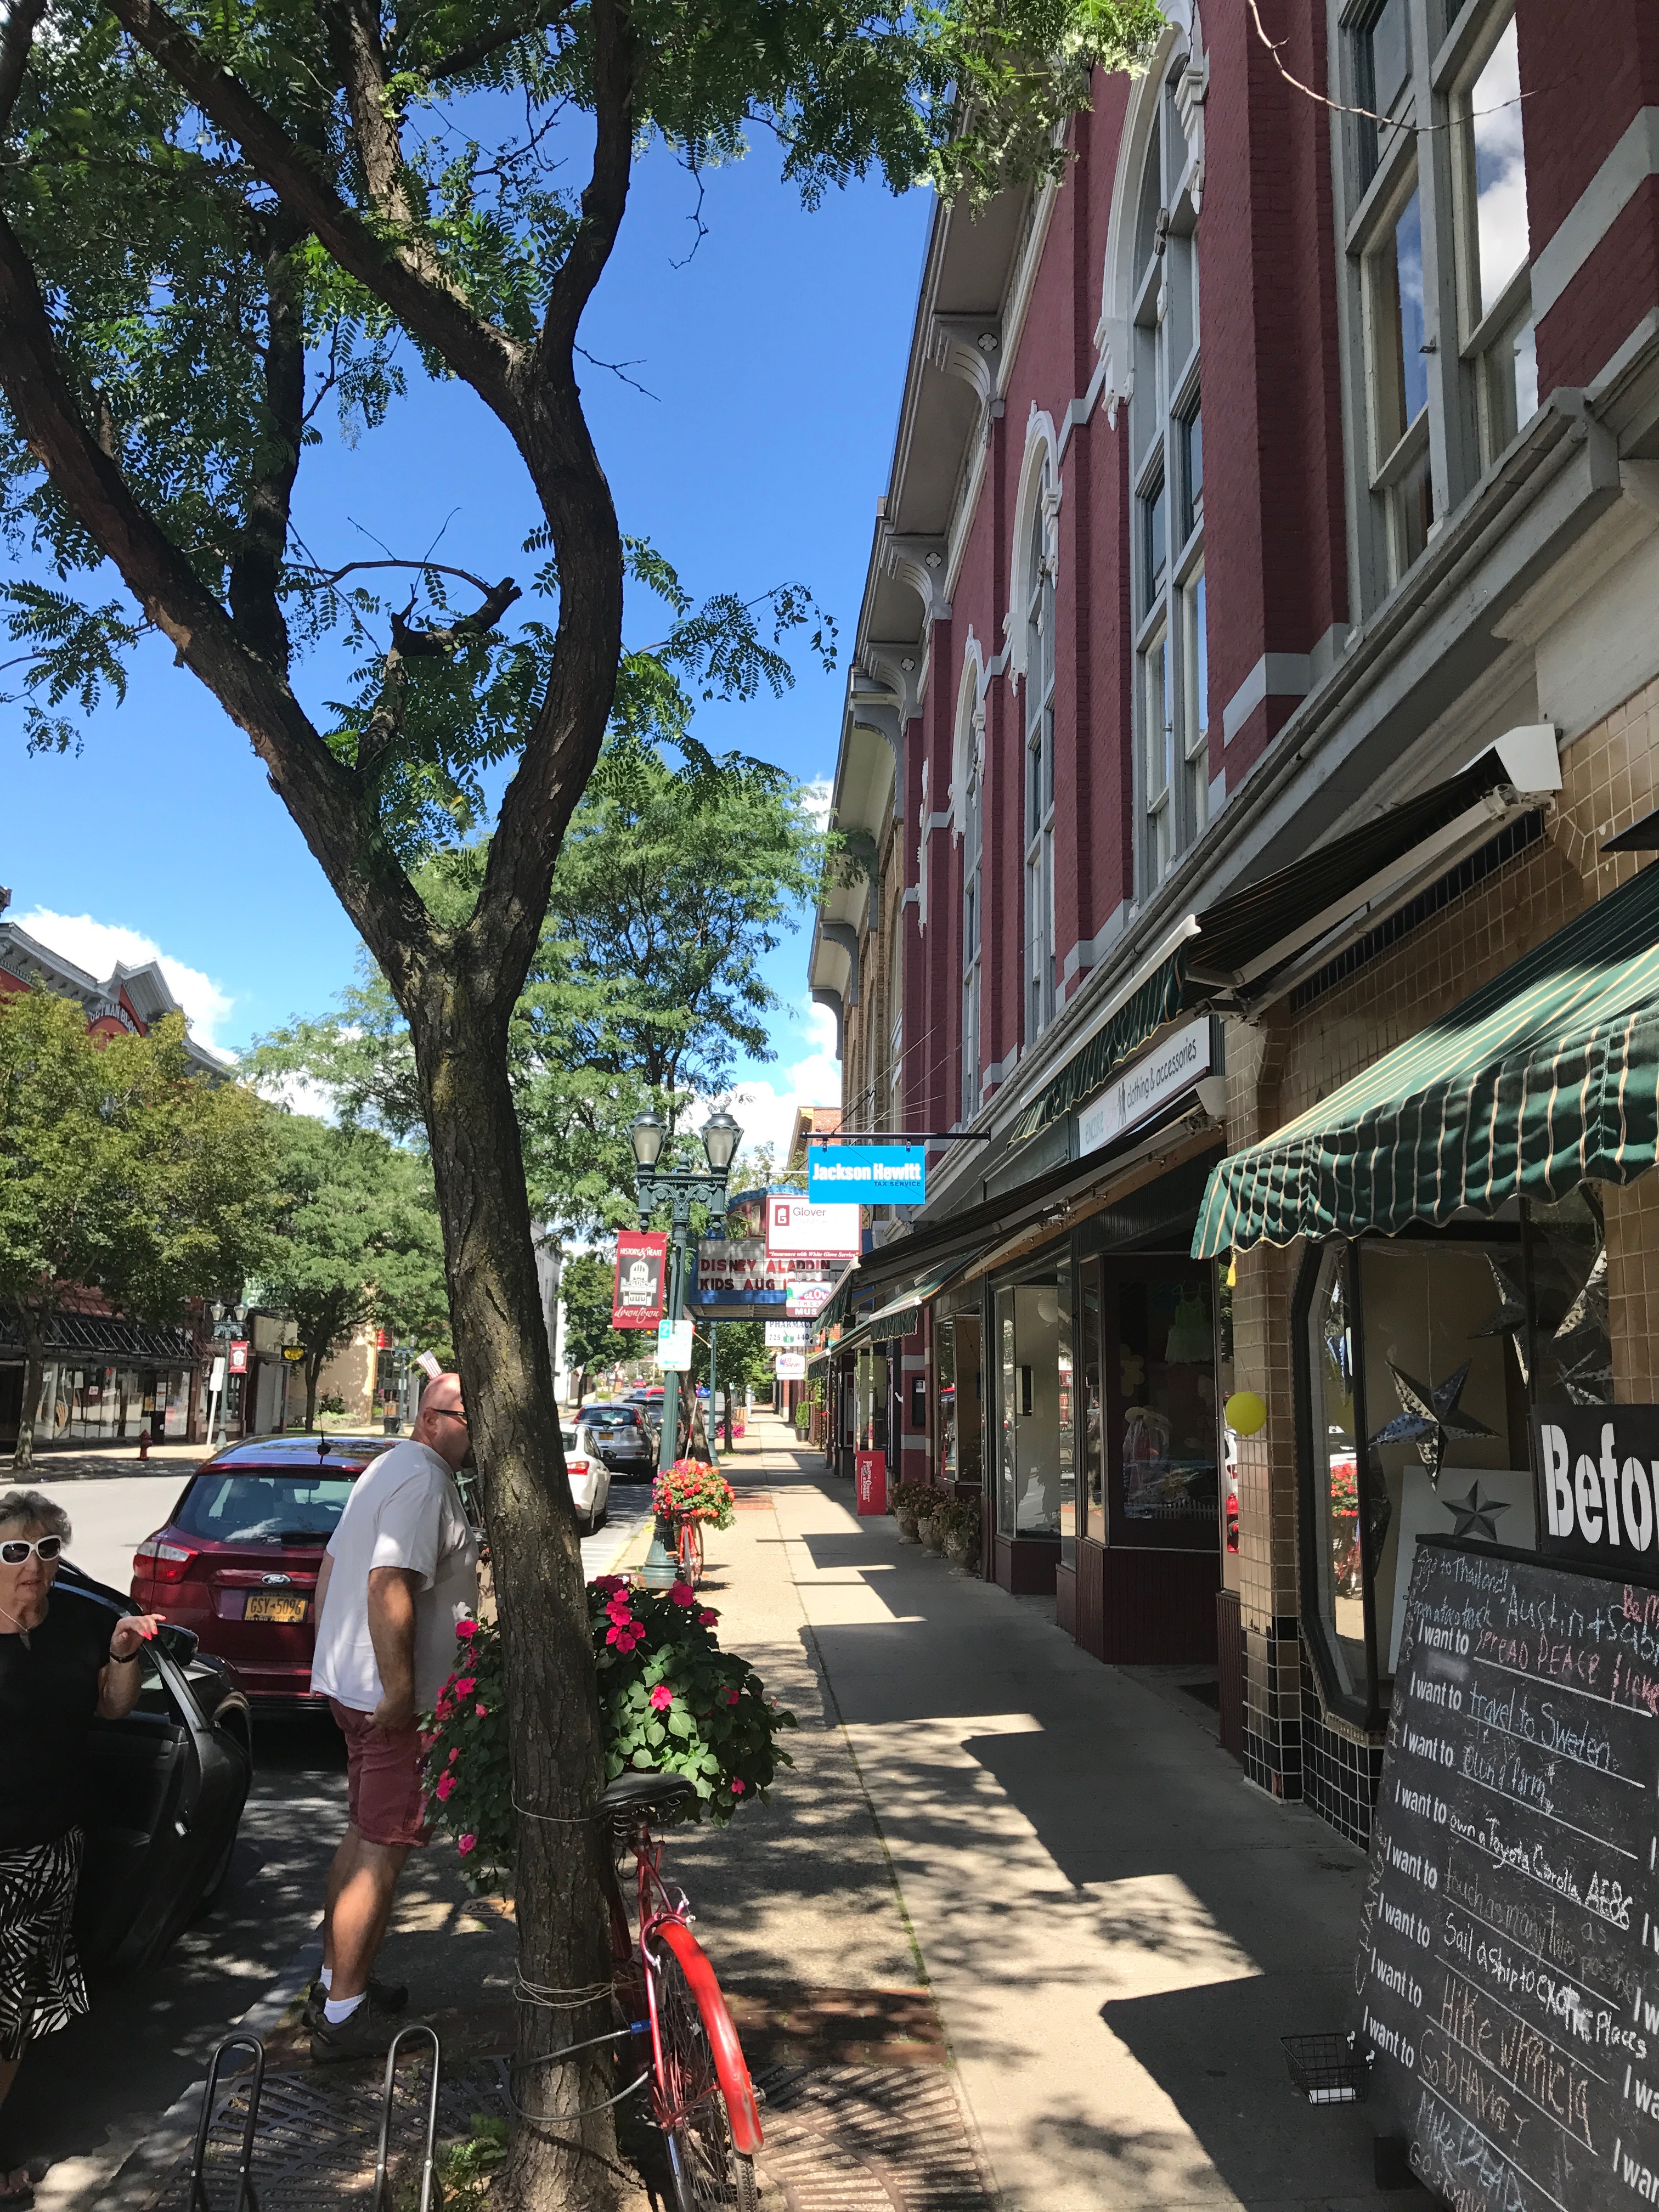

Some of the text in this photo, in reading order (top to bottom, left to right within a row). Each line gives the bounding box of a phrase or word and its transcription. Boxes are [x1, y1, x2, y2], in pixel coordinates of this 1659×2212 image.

[1127, 1076, 1149, 1108] clothing
[1156, 1037, 1197, 1086] accessories
[812, 1163, 921, 1181] Jackson Hewitt
[793, 1207, 827, 1216] Glover
[700, 1278, 735, 1290] KIDS
[743, 1278, 775, 1290] AUG
[701, 1259, 831, 1273] DISNEY ALADDIN
[614, 1305, 659, 1324] downtown
[662, 1324, 669, 1335] 2
[1541, 1423, 1659, 1551] Befo
[1418, 1618, 1424, 1642] I
[1425, 1626, 1454, 1651] want
[1455, 1629, 1469, 1656] to
[1410, 1671, 1416, 1696] I
[1417, 1679, 1447, 1706] want
[1448, 1684, 1462, 1711] to
[1469, 1680, 1516, 1731] travel
[1519, 1694, 1536, 1740] to
[1402, 1723, 1408, 1747] I
[1409, 1732, 1437, 1762] want
[1440, 1740, 1454, 1768] to
[1395, 1779, 1401, 1803] I
[1402, 1787, 1431, 1818] want
[1434, 1797, 1447, 1825] to
[1450, 1815, 1476, 1837] own
[1479, 1831, 1486, 1848] a
[1386, 1836, 1392, 1861] I
[1392, 1846, 1422, 1881] want
[1424, 1859, 1438, 1890] to
[1378, 1892, 1384, 1918] I
[1386, 1902, 1415, 1940] want
[1417, 1918, 1430, 1948] to
[1443, 1912, 1474, 1961] Sail
[1519, 1963, 1535, 1993] to
[1372, 1946, 1376, 1973] I
[1378, 1958, 1407, 1997] want
[1408, 1976, 1422, 2008] to
[1363, 2005, 1369, 2032] I
[1370, 2017, 1399, 2058] want
[1401, 2036, 1414, 2069] to
